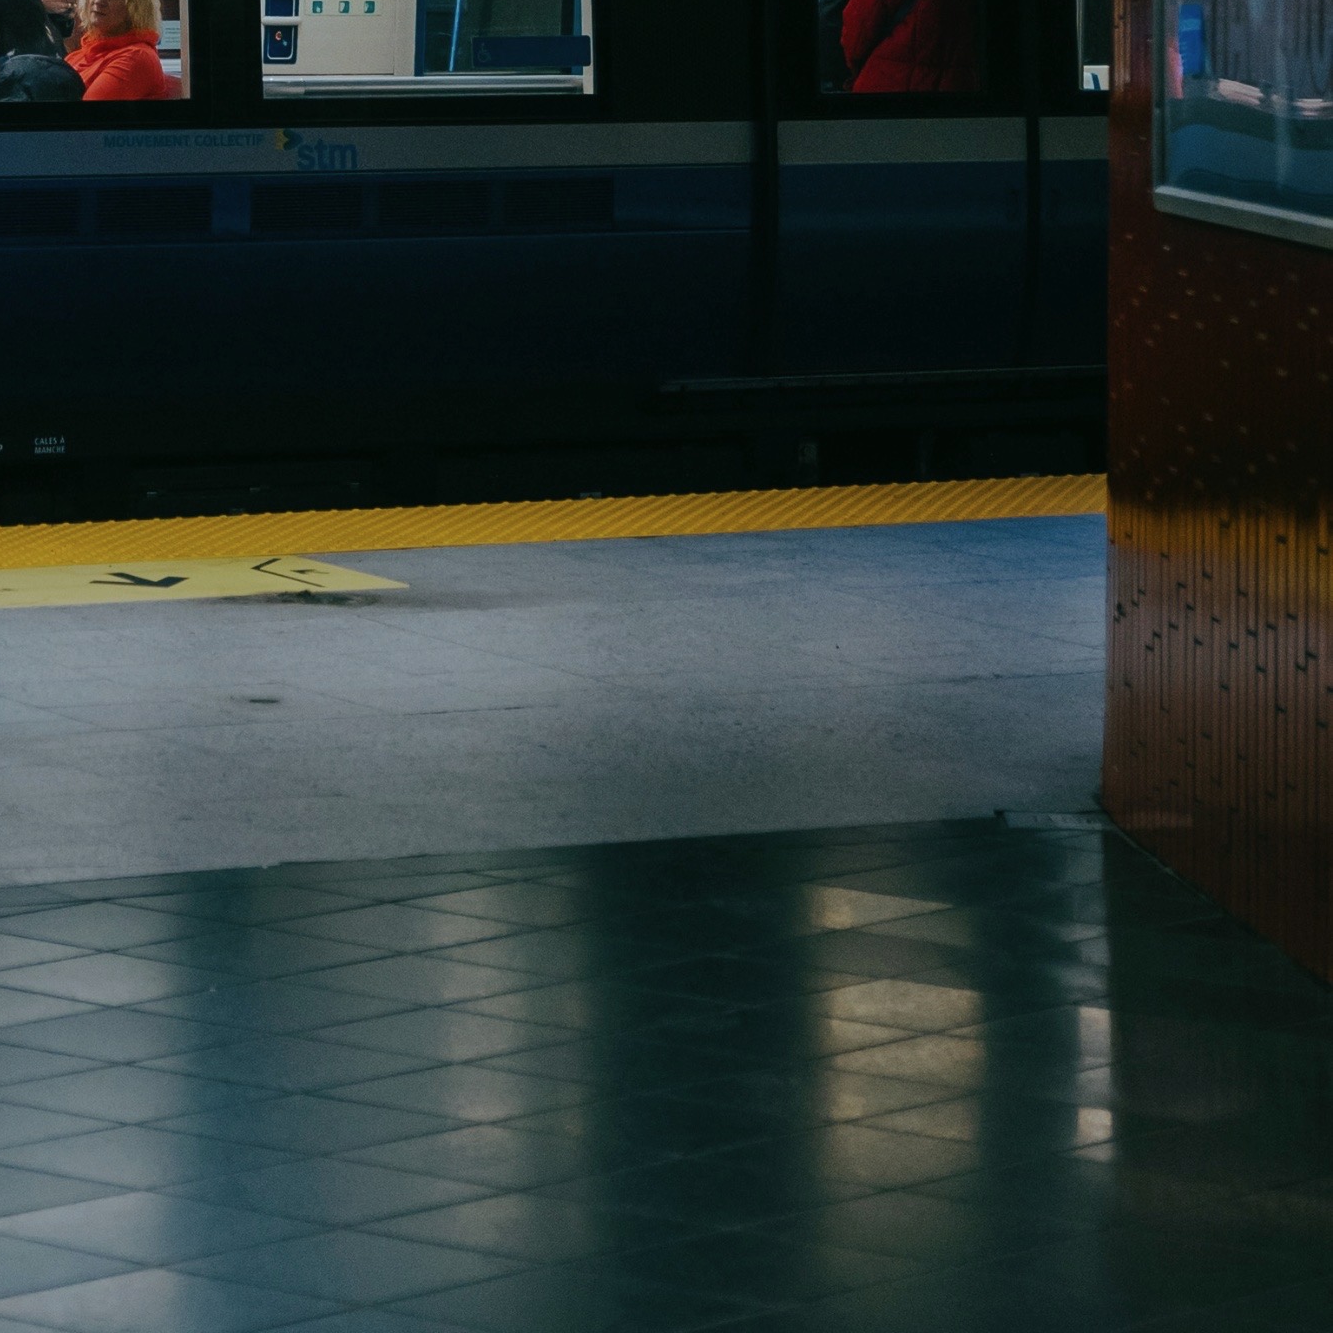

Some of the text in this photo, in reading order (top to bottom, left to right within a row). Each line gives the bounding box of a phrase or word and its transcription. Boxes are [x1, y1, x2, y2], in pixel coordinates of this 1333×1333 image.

[103, 134, 264, 148] MOUVEMENT COLLECTIF
[297, 138, 358, 170] stm
